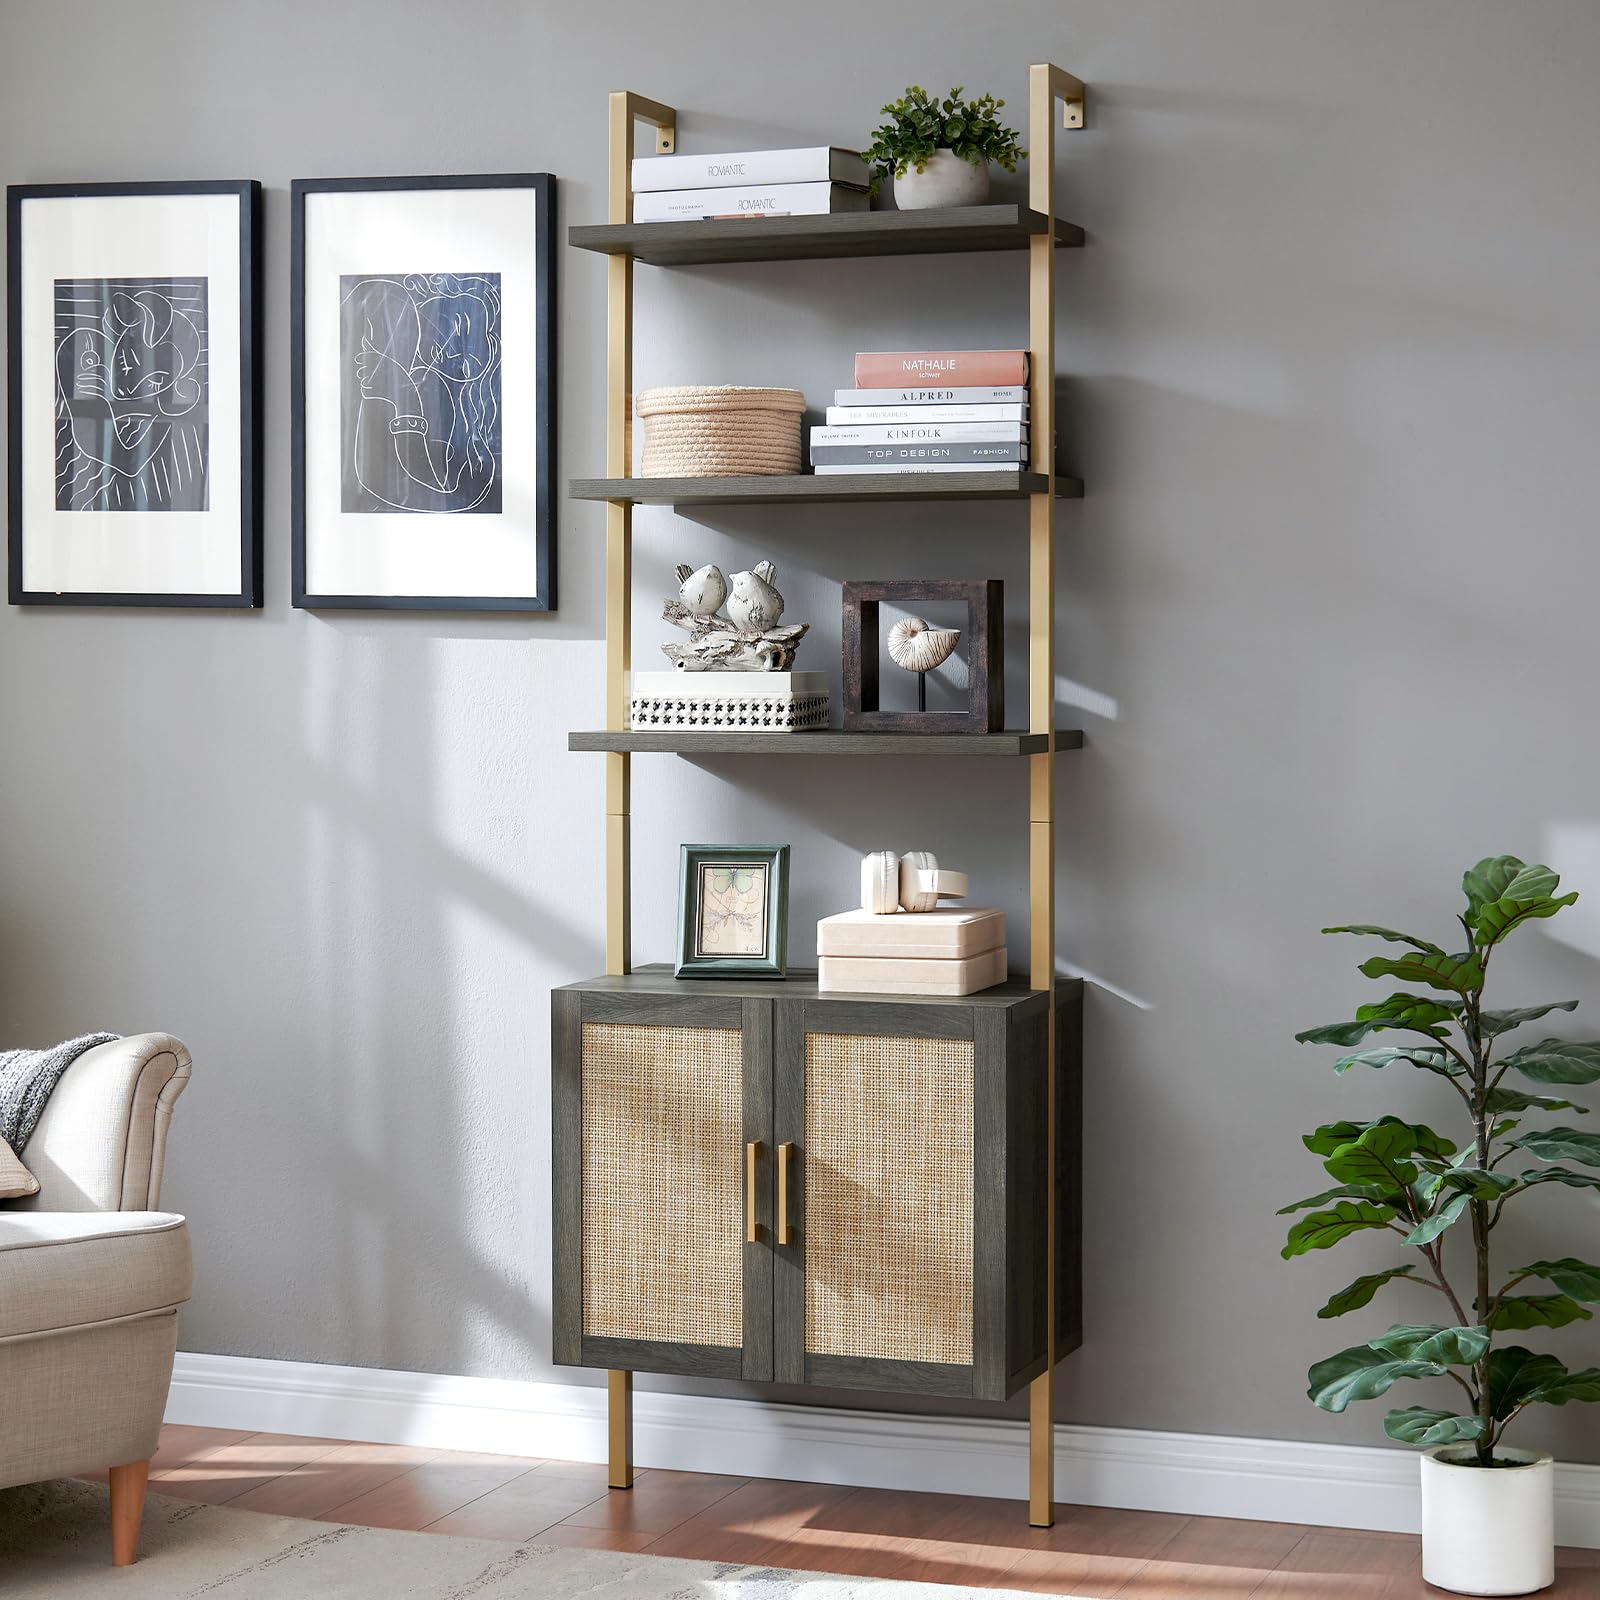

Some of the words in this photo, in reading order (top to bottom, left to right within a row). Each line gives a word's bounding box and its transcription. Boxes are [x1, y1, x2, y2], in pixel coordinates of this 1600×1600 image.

[707, 163, 745, 177] ROMANTIC
[738, 197, 776, 210] ROMANTIC
[902, 359, 956, 371] NATHALIE
[900, 391, 954, 401] ALPRED
[887, 429, 942, 439] KINFOLK
[867, 450, 893, 459] TOP
[900, 449, 950, 458] DESIGN
